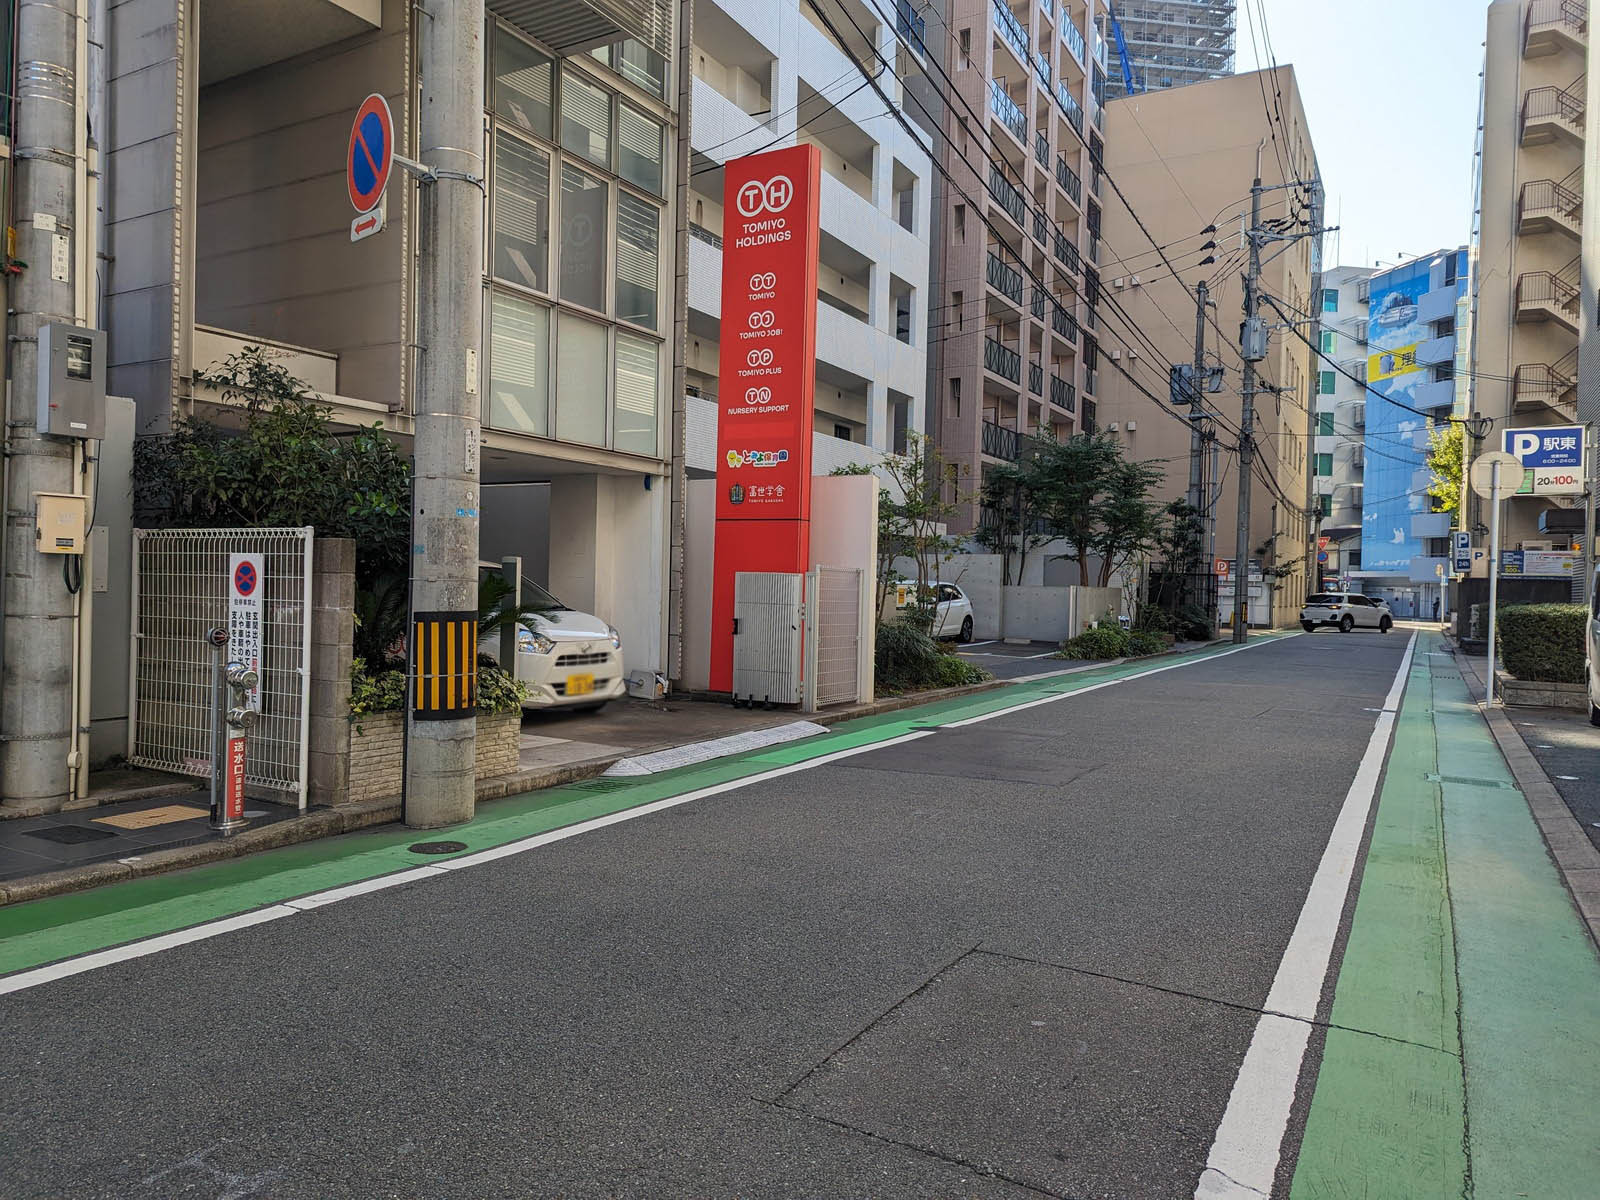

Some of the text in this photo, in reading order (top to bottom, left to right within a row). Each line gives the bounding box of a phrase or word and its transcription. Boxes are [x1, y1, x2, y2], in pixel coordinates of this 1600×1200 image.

[741, 180, 789, 213] TH
[742, 218, 786, 234] TOMIYO
[736, 231, 791, 248] HOLDINGS
[747, 291, 776, 301] TOMIYO
[739, 329, 783, 339] TOMIYO JOB!
[738, 367, 782, 377] TOMIYO PLUS
[728, 405, 790, 416] NURSERY SUPPORT
[742, 450, 788, 463] とみよ保育園
[1514, 434, 1577, 467] P 駅東
[1458, 535, 1468, 547] P
[1474, 552, 1483, 560] P
